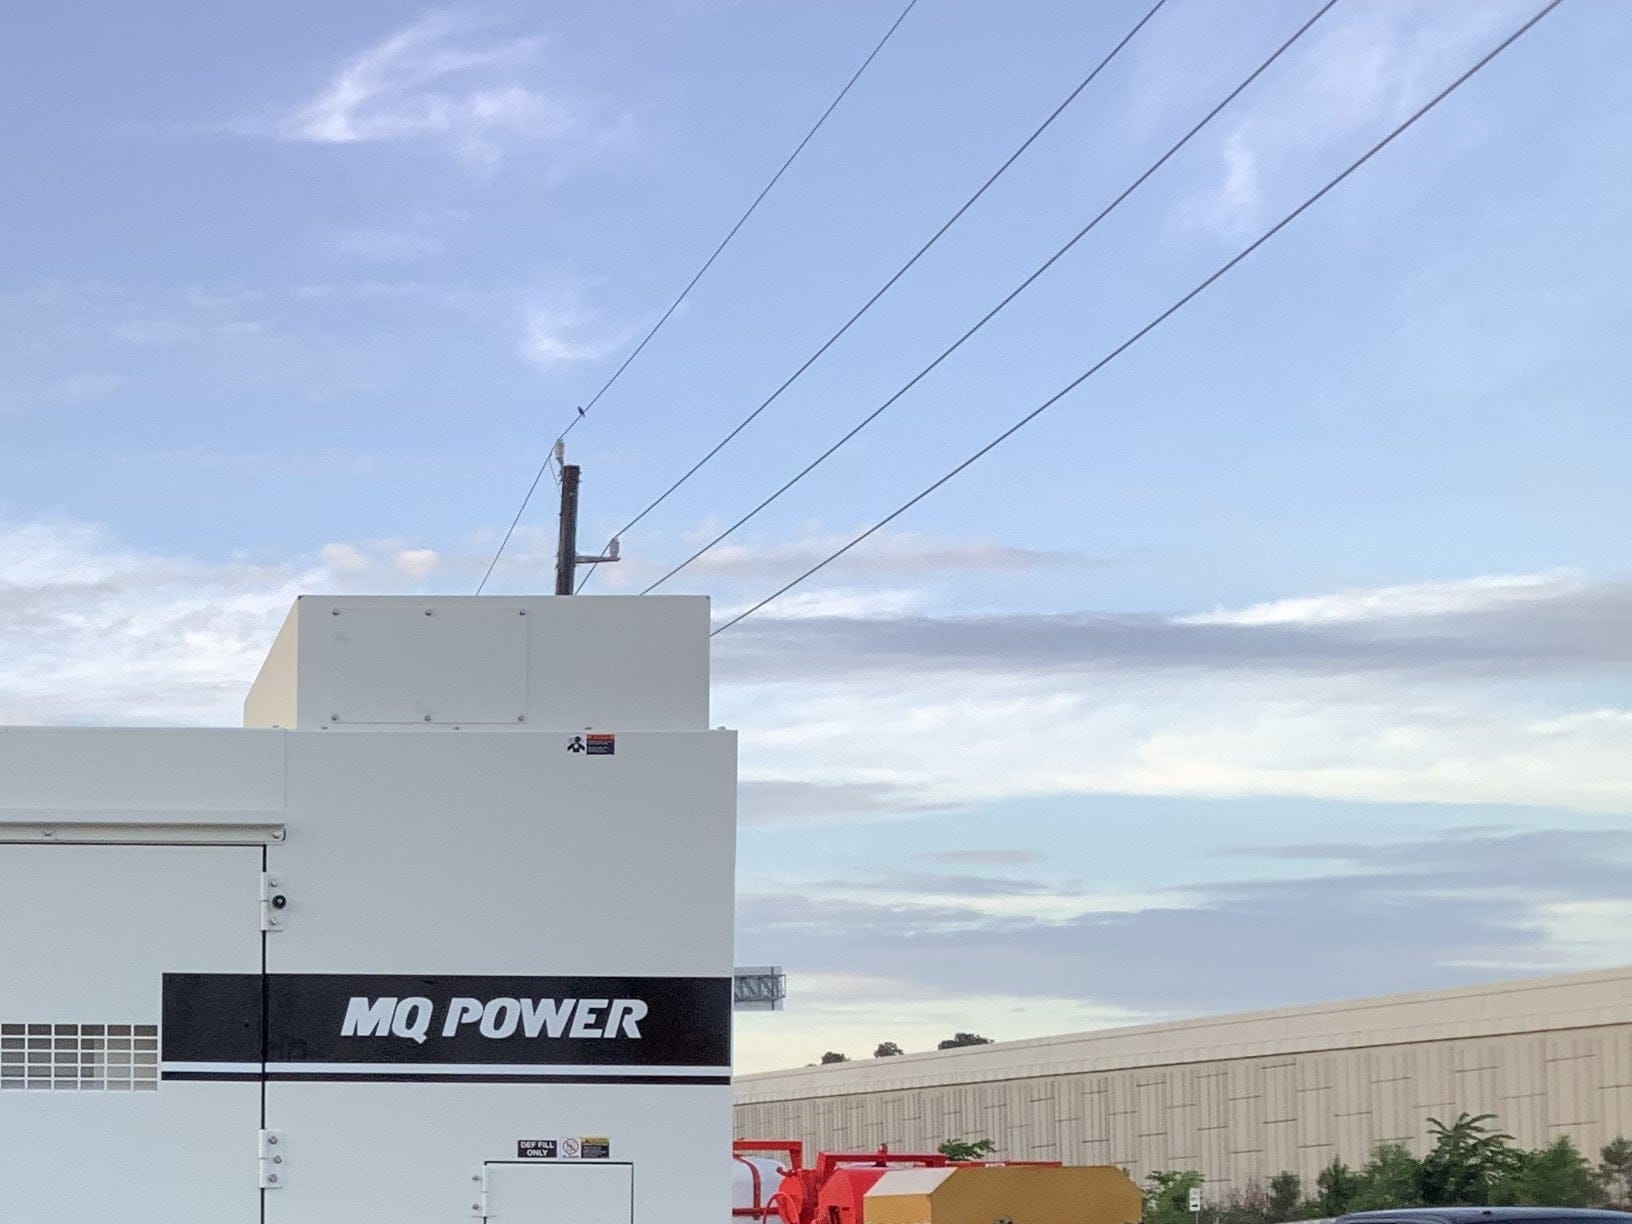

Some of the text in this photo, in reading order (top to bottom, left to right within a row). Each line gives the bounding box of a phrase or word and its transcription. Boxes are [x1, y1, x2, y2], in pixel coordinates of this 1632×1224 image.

[340, 996, 649, 1043] MQ POWER
[520, 1141, 555, 1149] DEF FILL
[527, 1149, 548, 1157] ONLY
